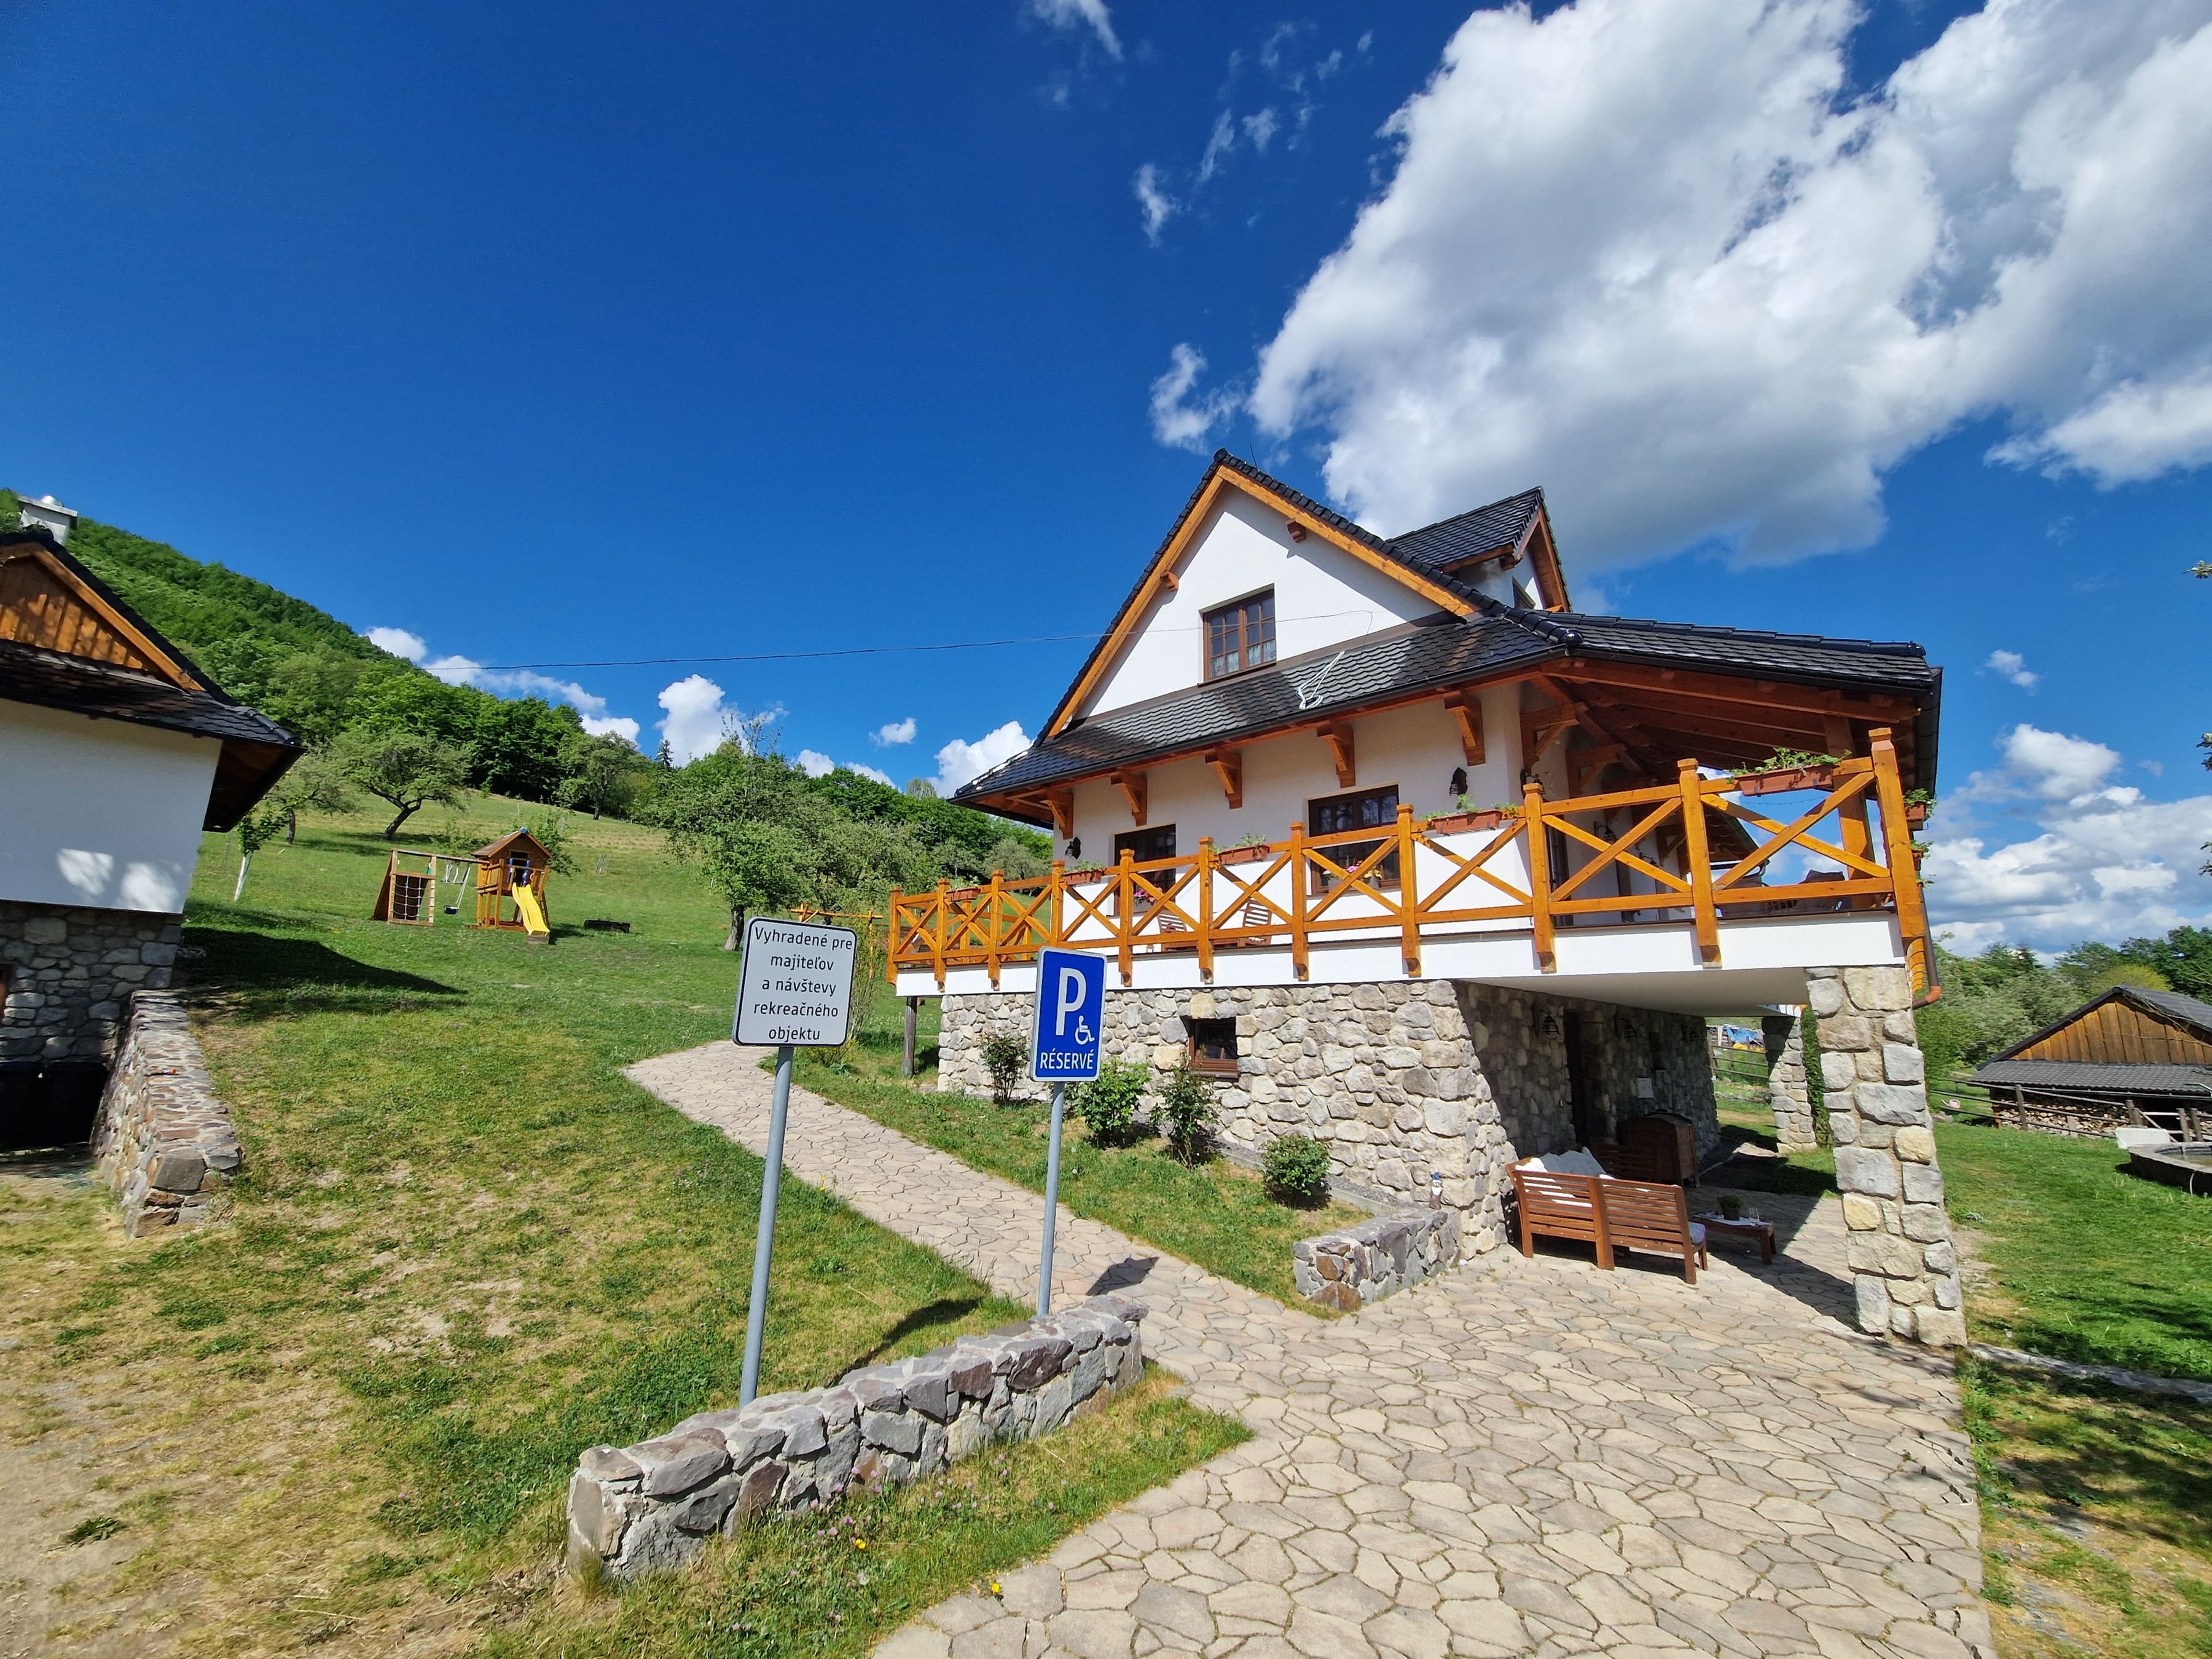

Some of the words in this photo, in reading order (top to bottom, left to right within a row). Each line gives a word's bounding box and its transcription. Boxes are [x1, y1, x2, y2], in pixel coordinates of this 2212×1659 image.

[755, 927, 828, 947] Vyhradené
[832, 938, 853, 951] pre
[771, 954, 834, 971] majiteľov
[762, 979, 769, 990] a
[776, 977, 836, 997] návštevy
[754, 1002, 839, 1017] rekreačného
[1056, 967, 1087, 1036] P
[769, 1026, 820, 1042] objektu
[1040, 1048, 1094, 1069] RÉSERVÉ
